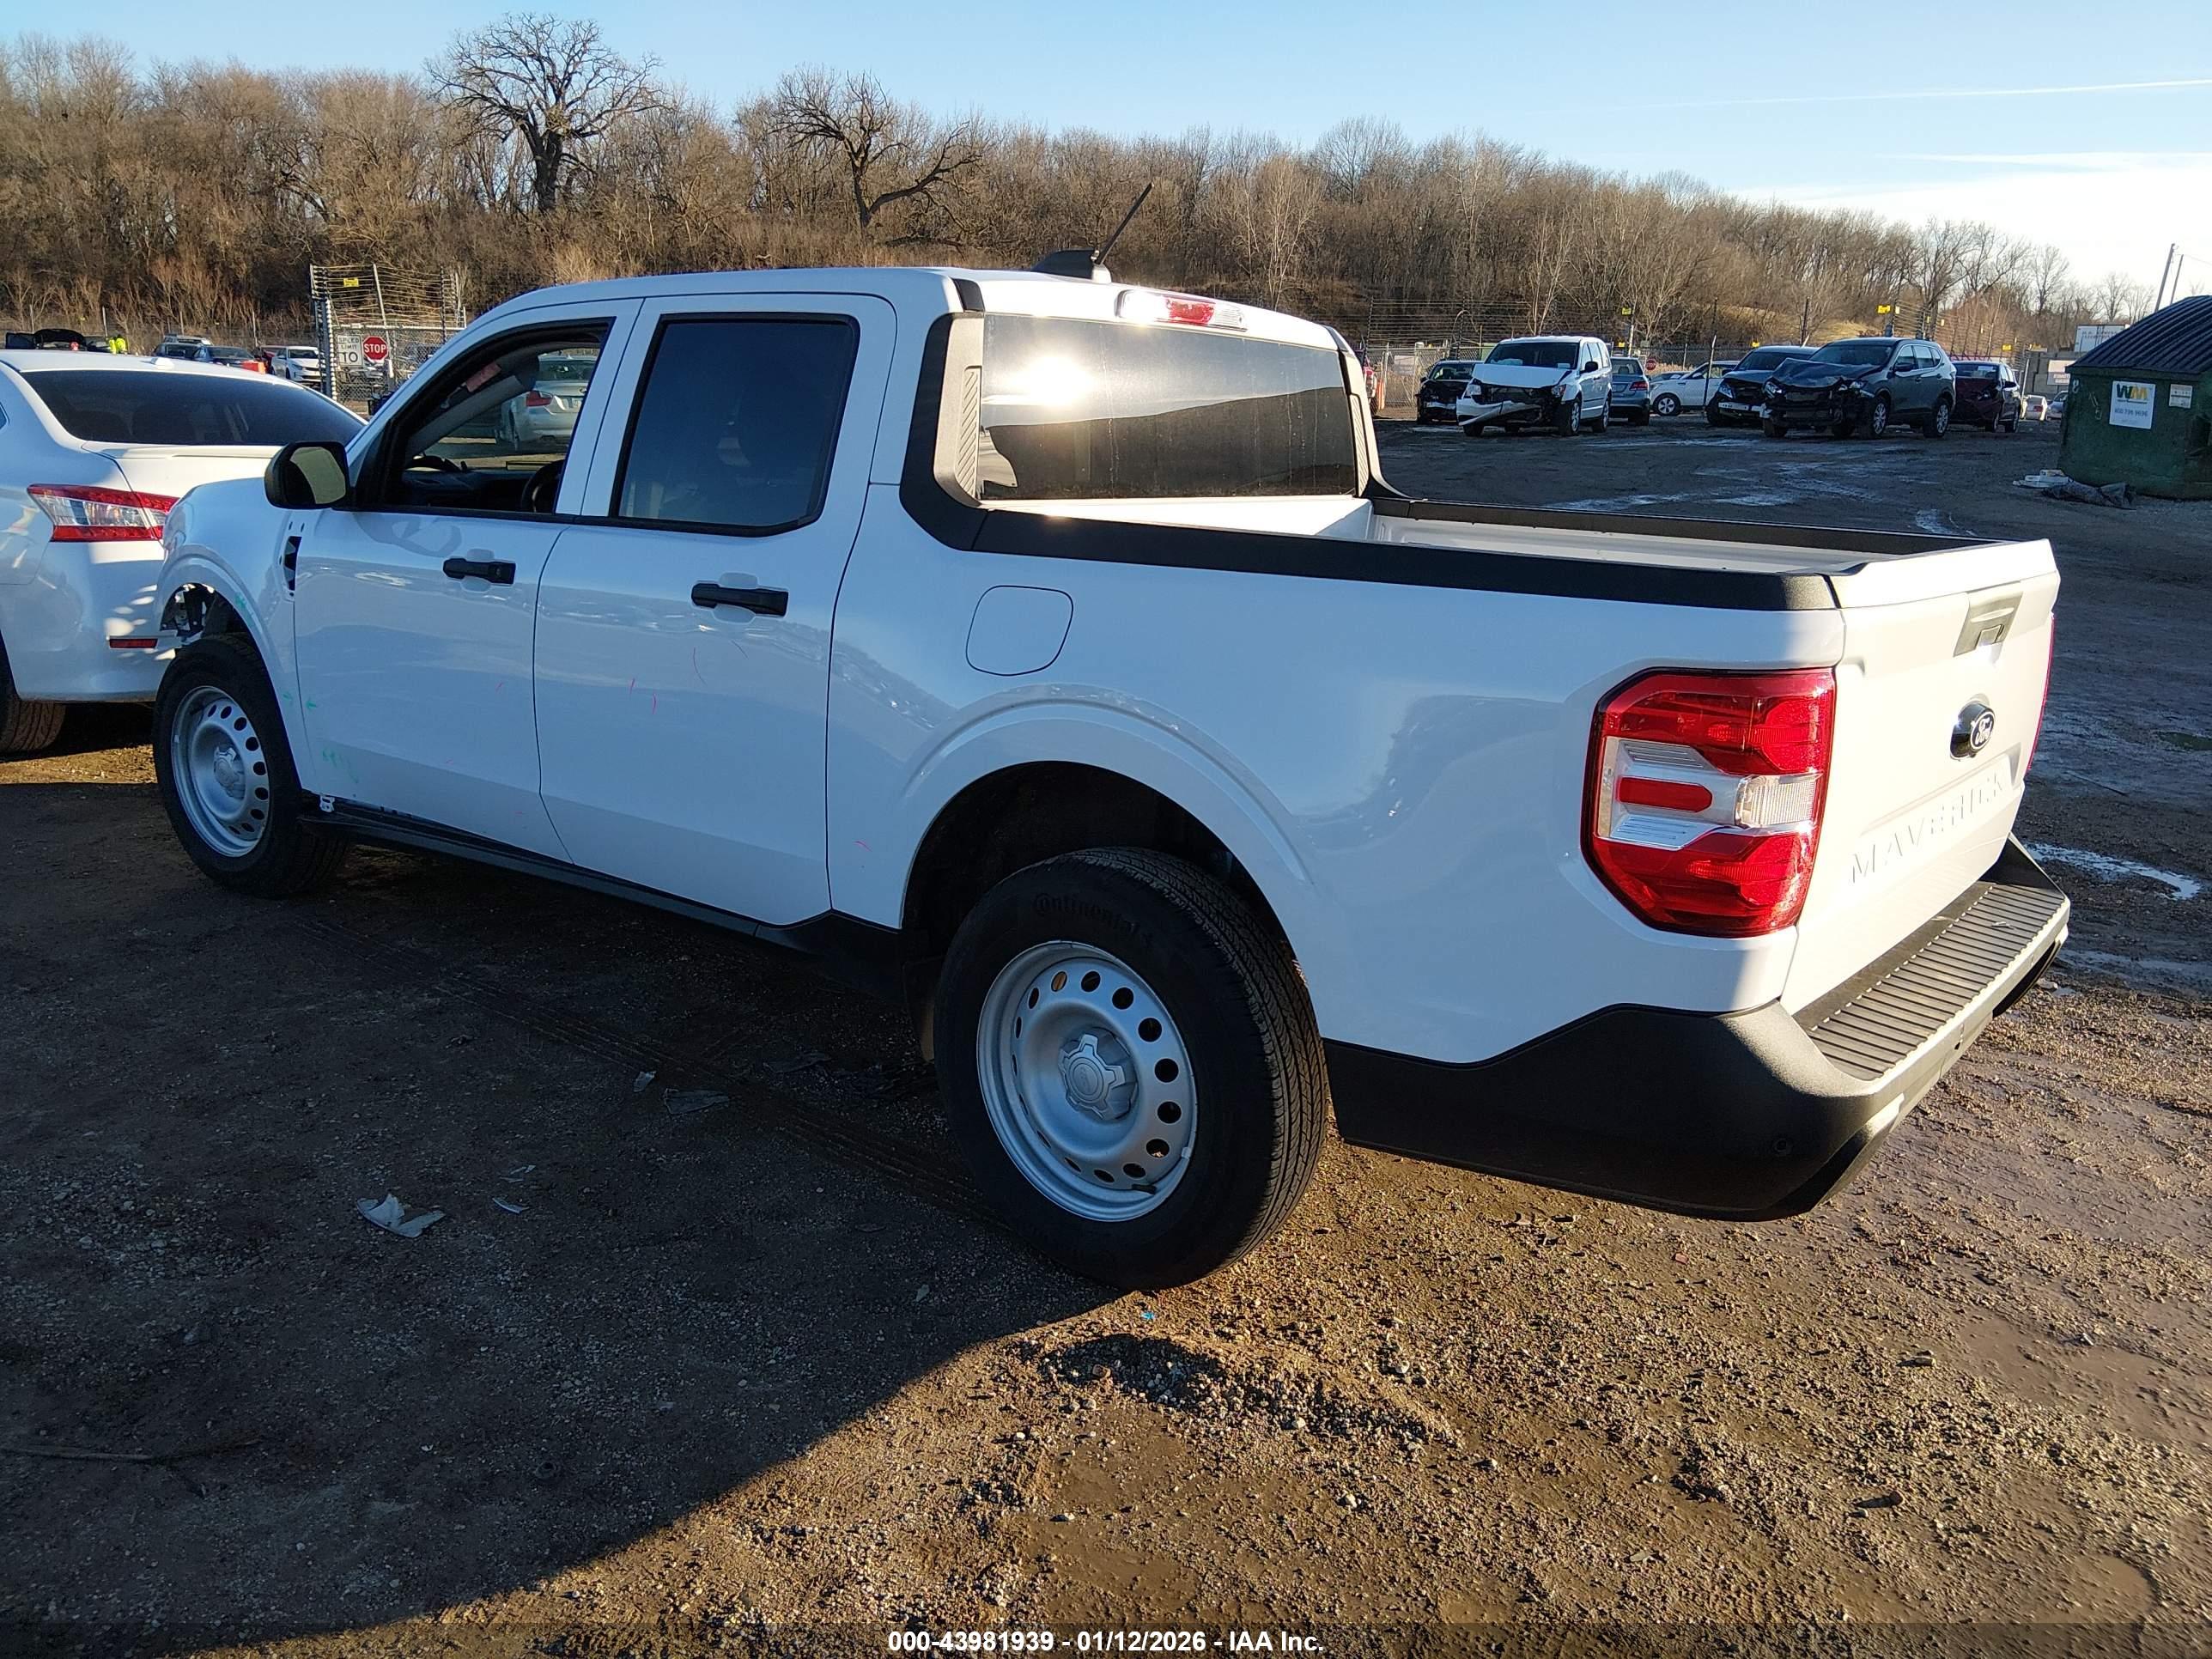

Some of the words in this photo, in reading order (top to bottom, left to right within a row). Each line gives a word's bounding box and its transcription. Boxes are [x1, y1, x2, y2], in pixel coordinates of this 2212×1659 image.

[364, 343, 386, 354] STOP
[342, 351, 358, 362] 10
[2117, 383, 2147, 399] WM
[1849, 772, 2003, 884] MAVERICK
